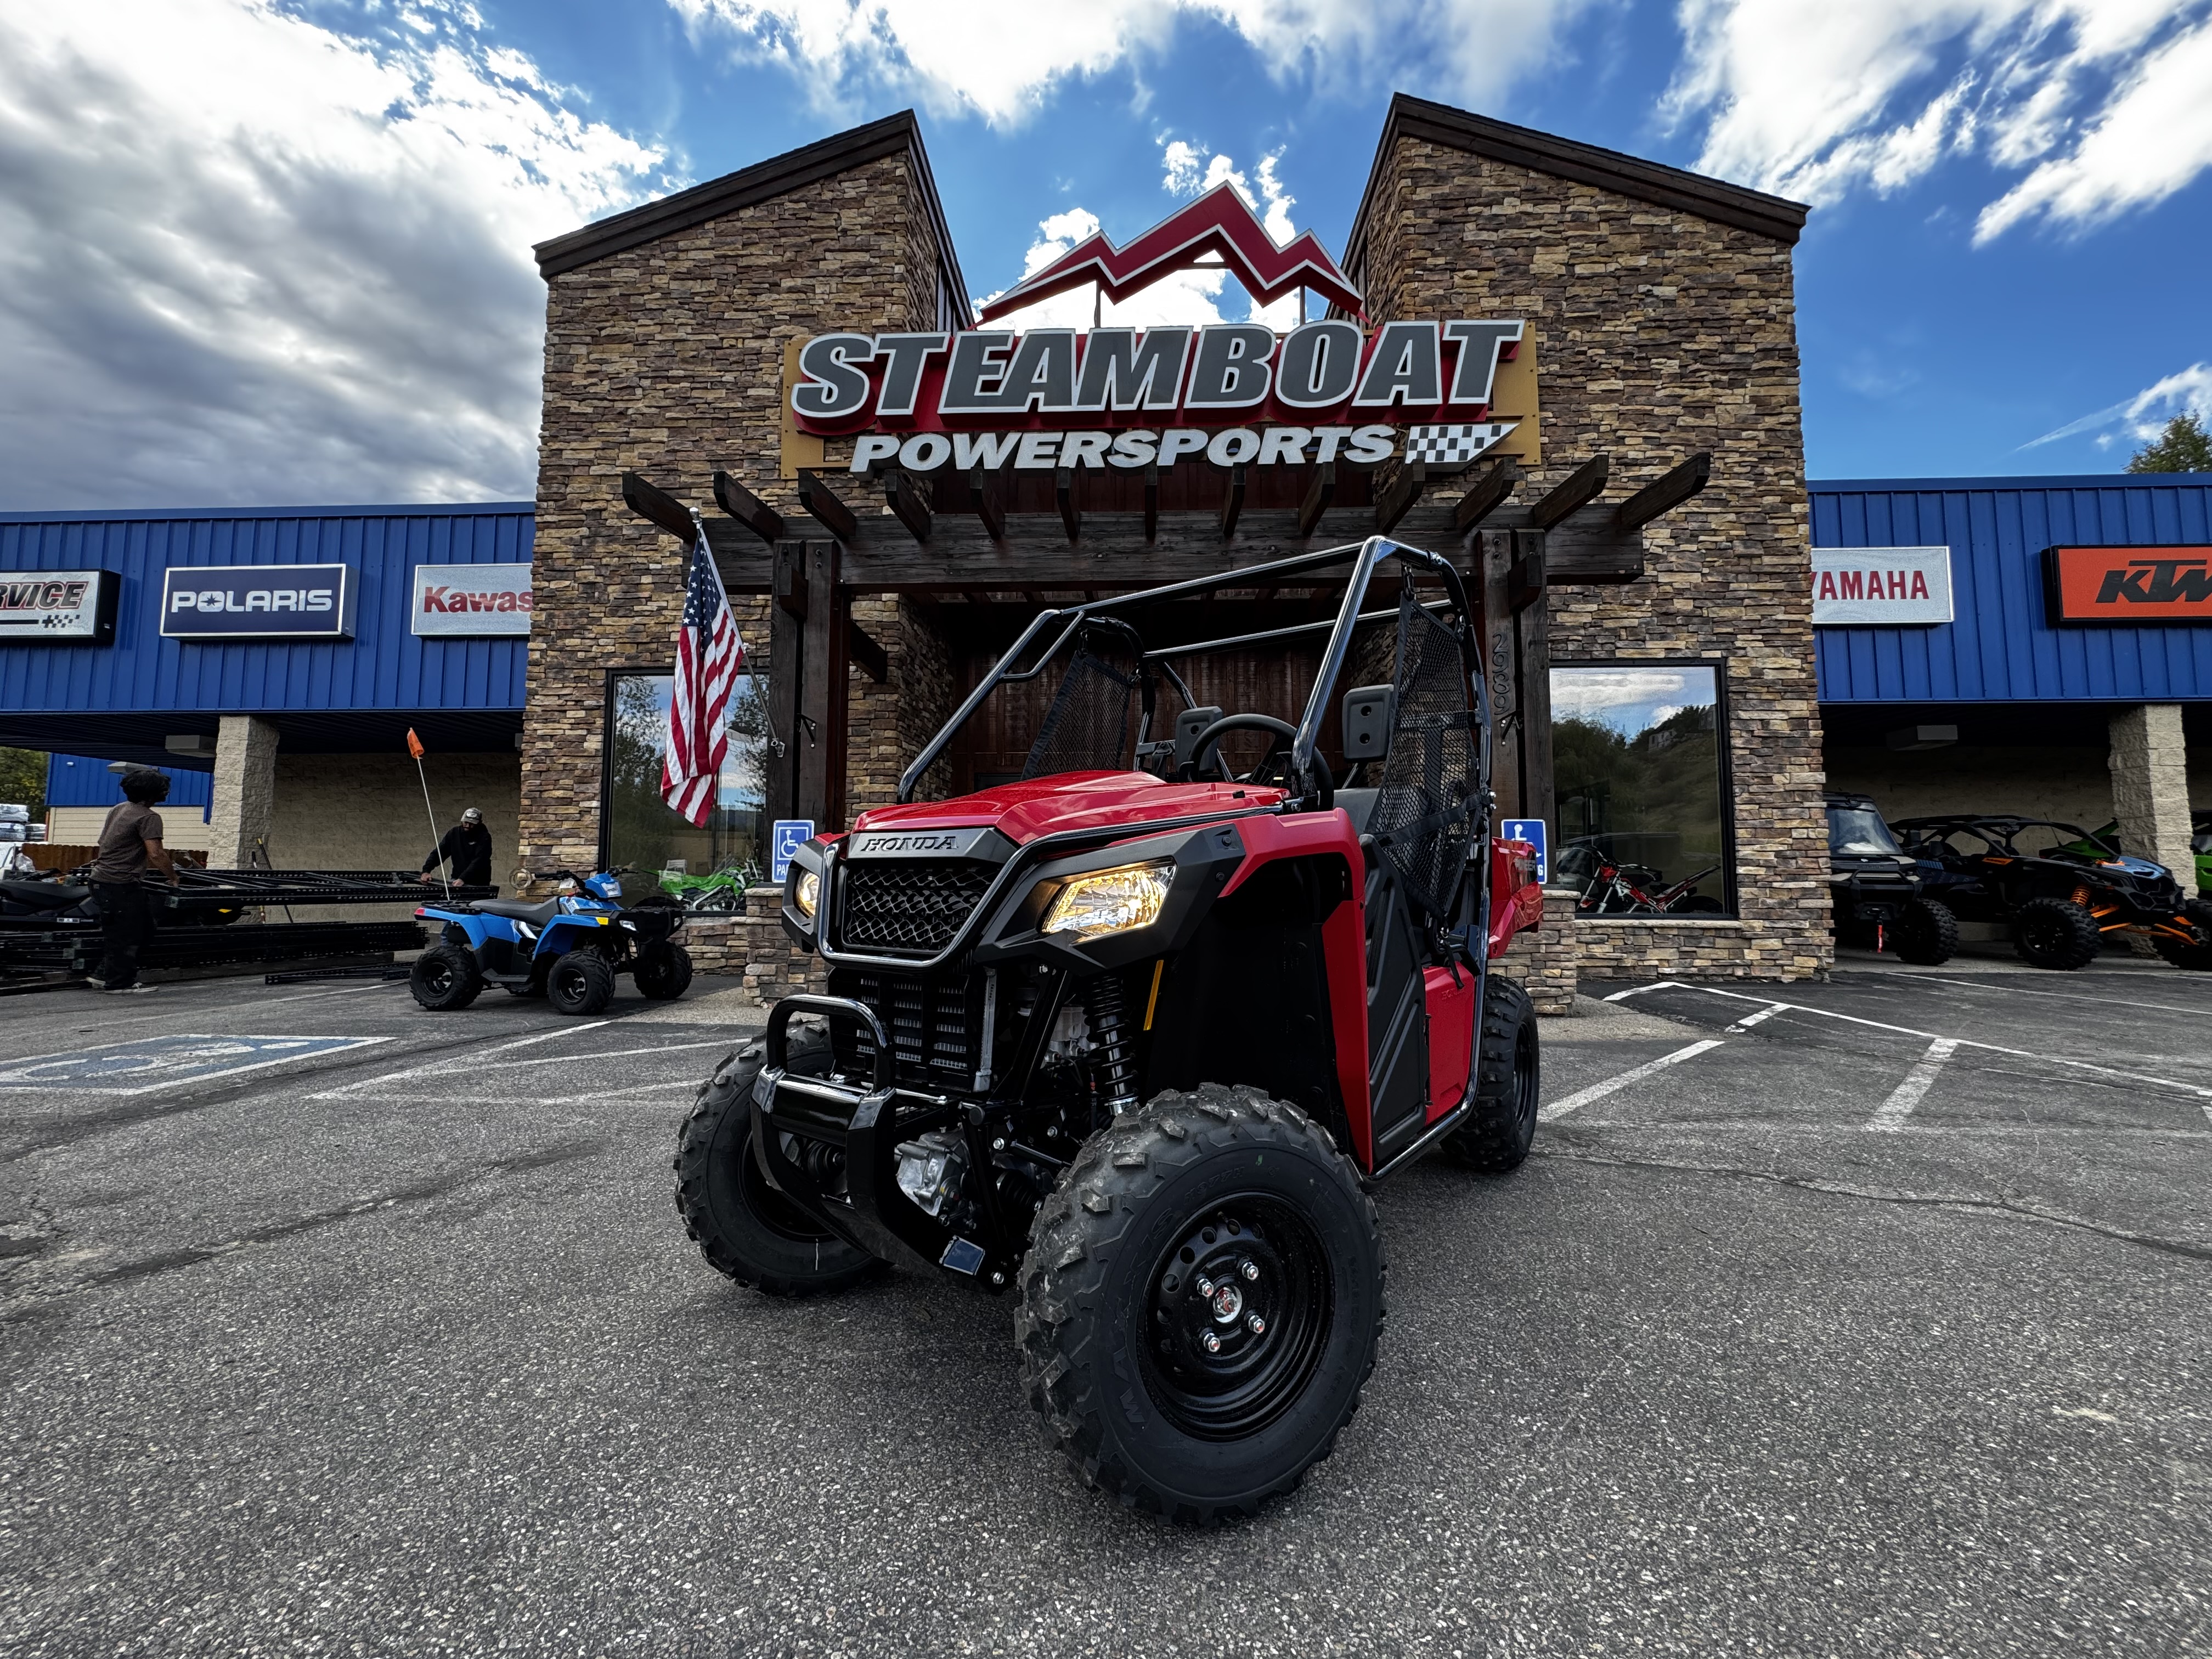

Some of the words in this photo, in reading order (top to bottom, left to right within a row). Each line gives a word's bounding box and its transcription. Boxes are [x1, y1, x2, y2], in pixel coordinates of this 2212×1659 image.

[791, 319, 1526, 419] STEAMBOAT
[849, 425, 1397, 473] POWERSPORTS
[171, 589, 332, 613] POLARIS
[1492, 633, 1510, 715] 2989
[860, 836, 958, 852] HONDA
